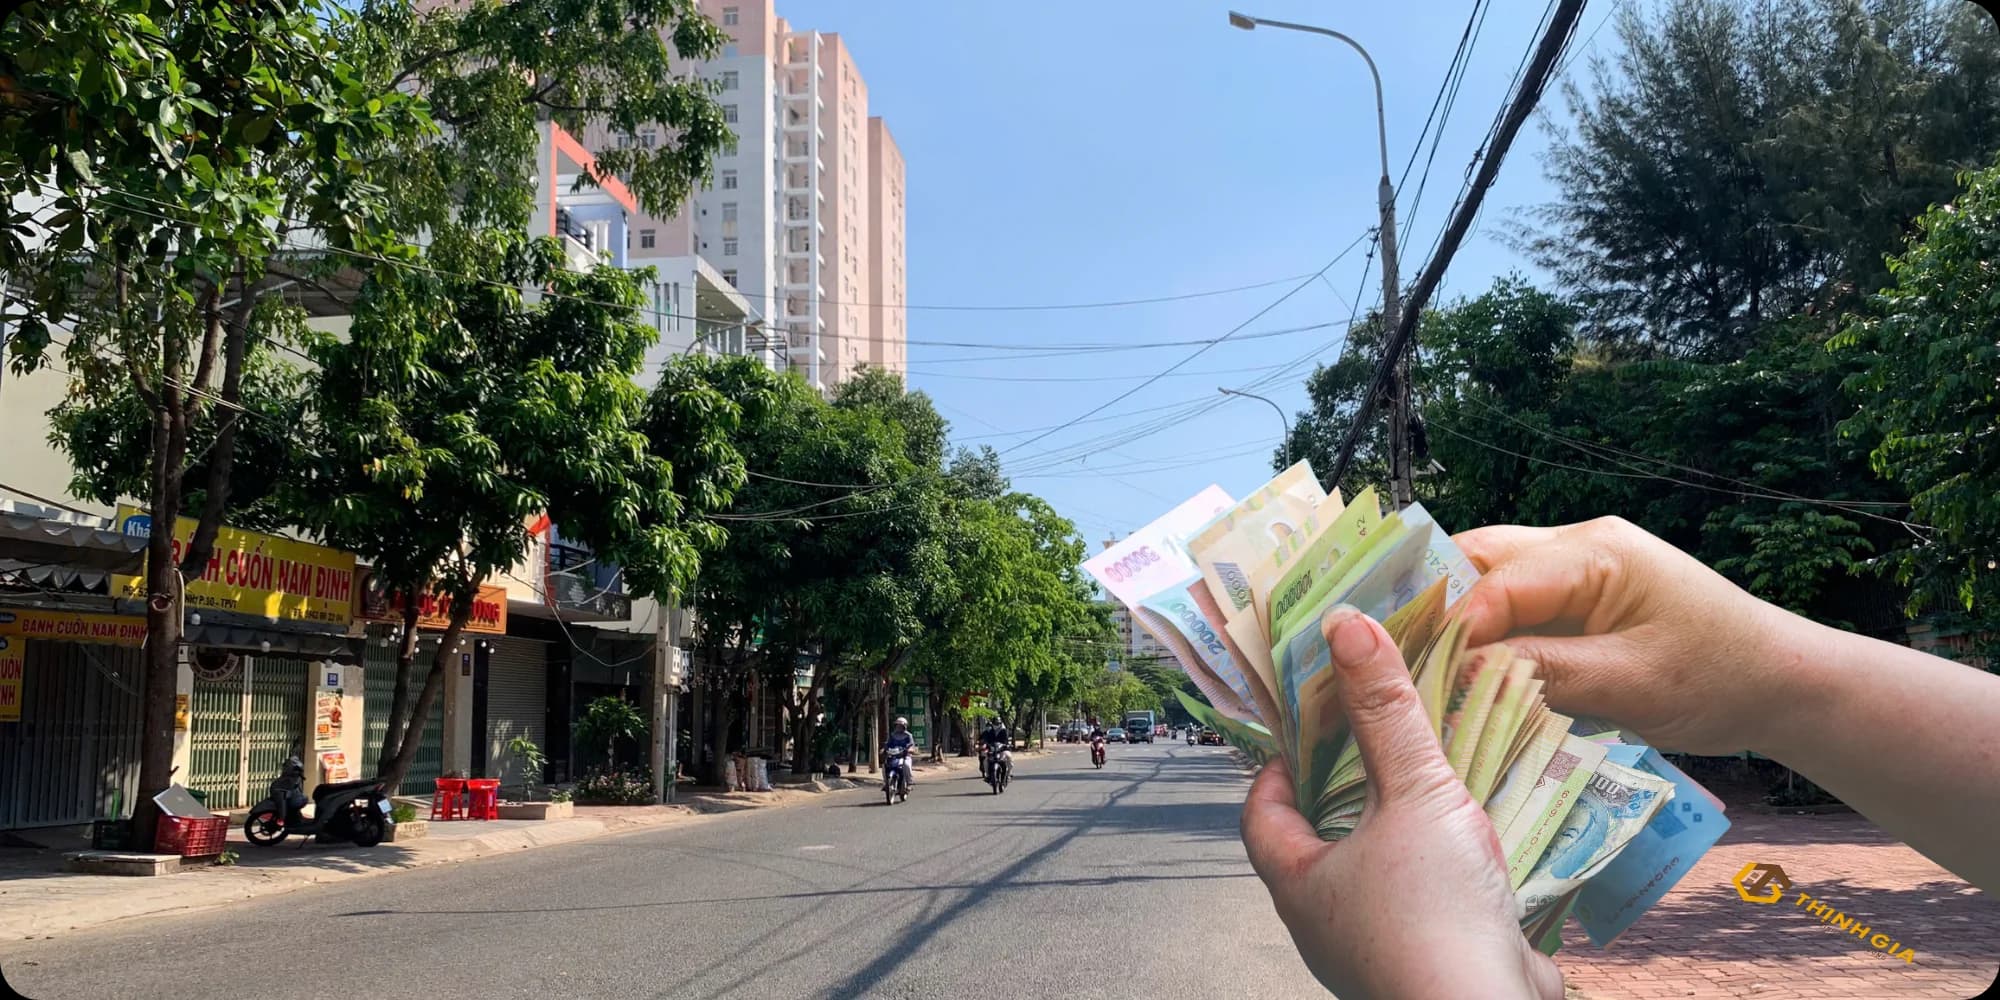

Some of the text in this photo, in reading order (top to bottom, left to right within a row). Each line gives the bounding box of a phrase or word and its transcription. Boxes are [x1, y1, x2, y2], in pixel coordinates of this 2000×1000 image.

[127, 521, 151, 537] Khá
[225, 540, 274, 591] CUỐN
[277, 560, 313, 597] NAM
[315, 565, 352, 609] ĐỊNH
[56, 617, 88, 635] CUỐN
[91, 622, 117, 638] NAM
[1171, 602, 1227, 655] 20000
[0, 652, 21, 681] UỐN
